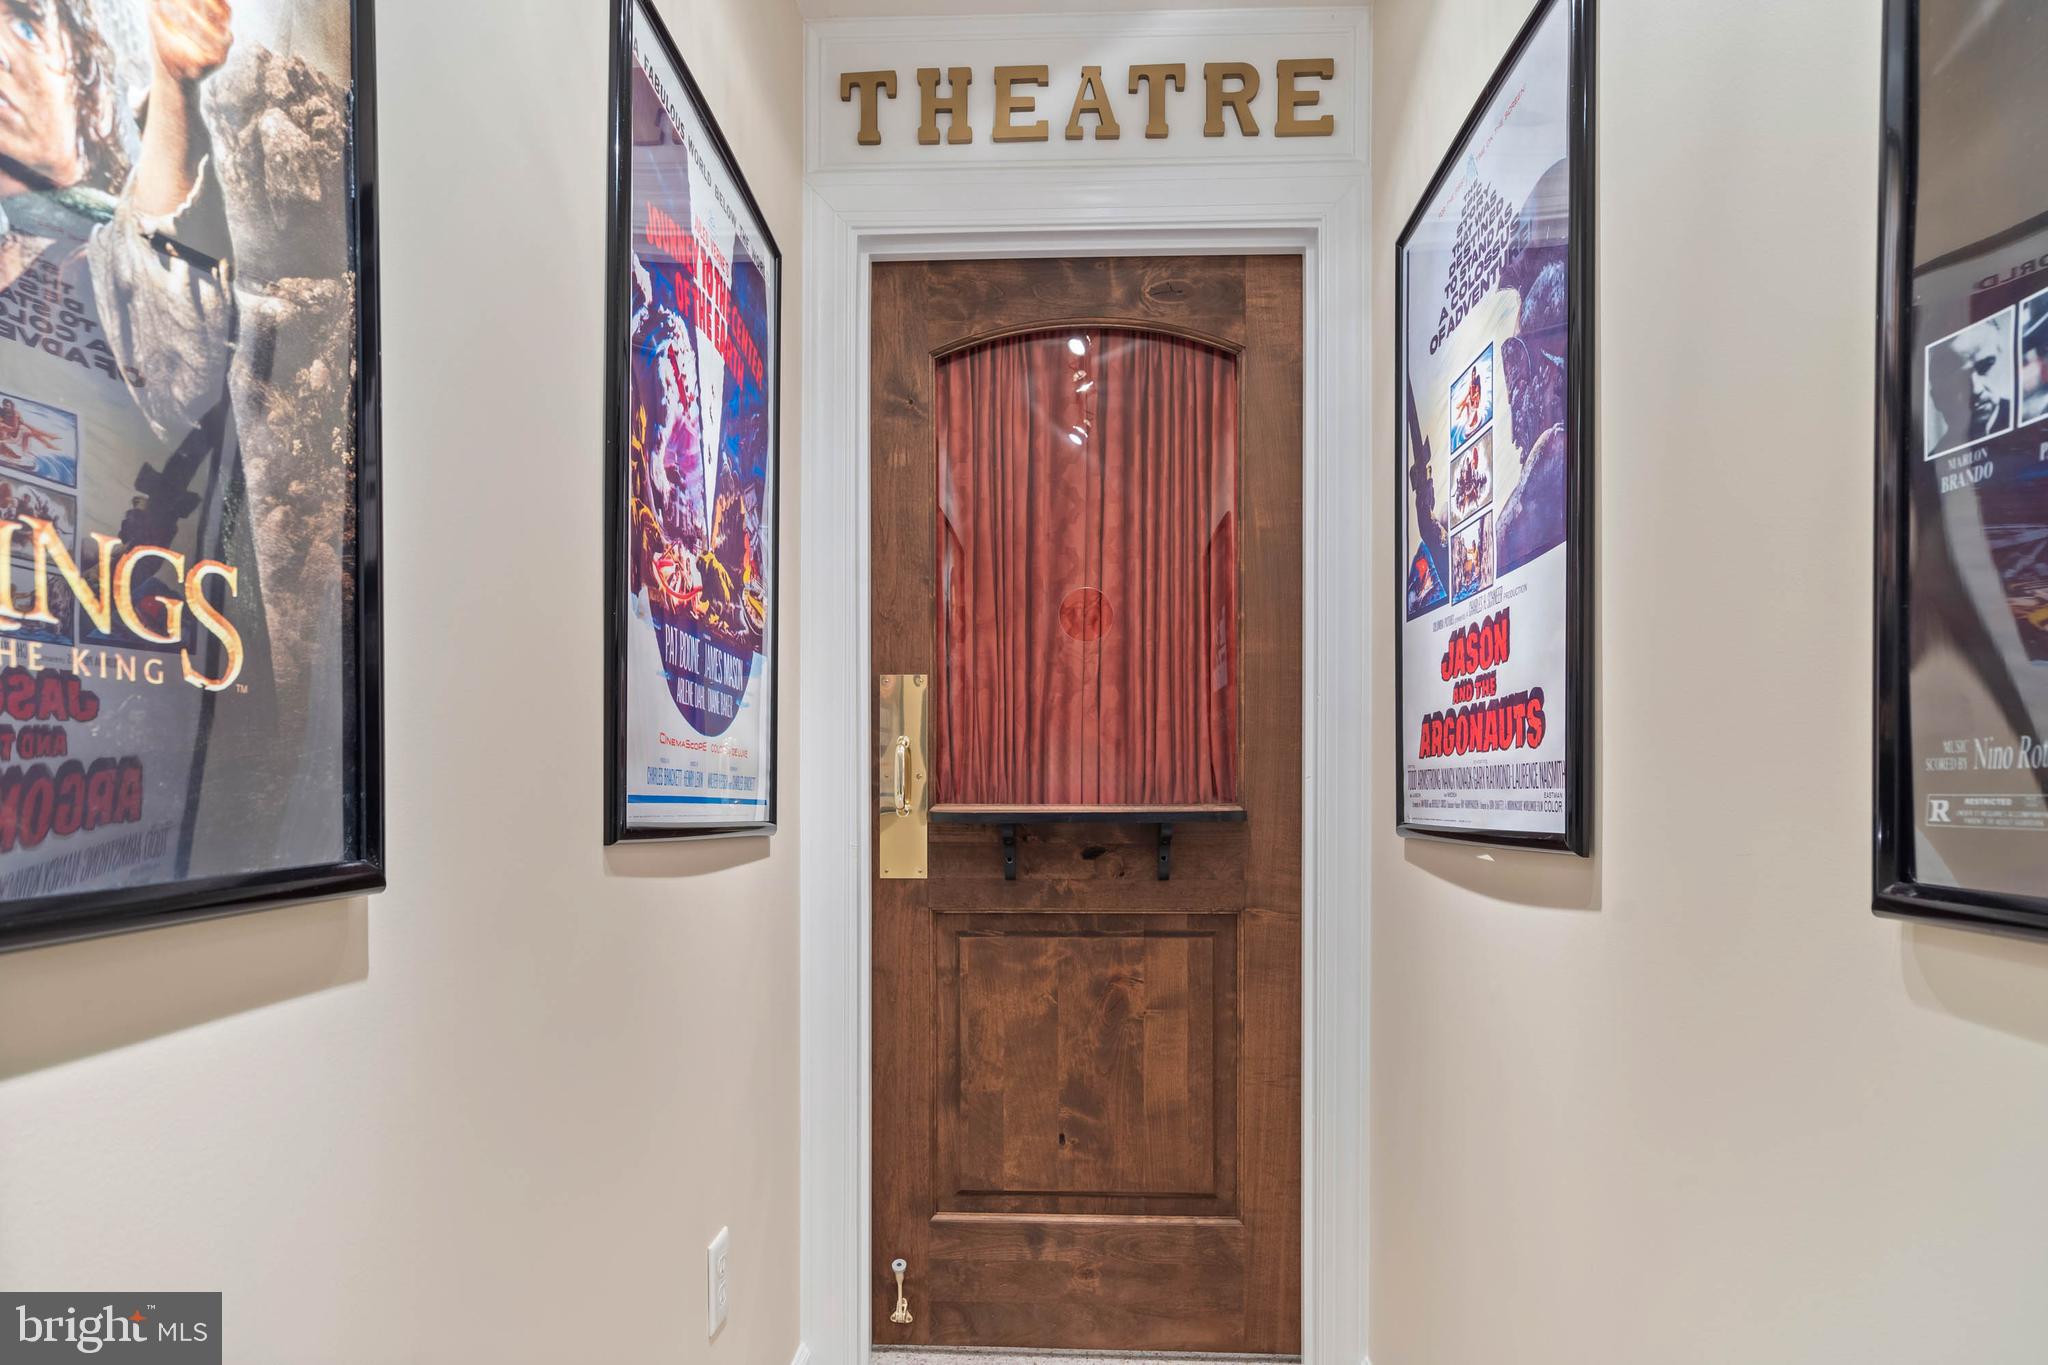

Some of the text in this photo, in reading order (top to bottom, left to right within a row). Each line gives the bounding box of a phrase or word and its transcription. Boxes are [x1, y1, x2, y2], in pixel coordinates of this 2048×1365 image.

[840, 57, 1335, 146] THEATRE
[644, 54, 685, 140] FABULOUS
[688, 136, 712, 188] WORLD
[714, 185, 737, 229] BELOW
[1452, 189, 1497, 258] THAT WAS
[1456, 181, 1491, 239] STORY
[1461, 182, 1483, 217] EPIC
[1438, 306, 1449, 327] A
[1450, 211, 1520, 310] COLOSSUS
[1444, 201, 1513, 300] TO STAND AS
[1449, 197, 1504, 280] DESTINED
[646, 201, 698, 280] JOURNEY
[701, 250, 713, 298] TO
[732, 304, 763, 391] CENTER
[675, 271, 744, 391] OF THE EARTH
[1429, 325, 1446, 356] OF
[1941, 461, 1994, 494] BRANDO
[1948, 447, 1988, 470] MARLON
[0, 514, 244, 692] INGS
[71, 646, 165, 686] KING
[665, 623, 744, 692] PAT BOONE JAMES MASON
[1440, 606, 1510, 682] JASON
[1453, 670, 1497, 705] AND THE
[1419, 687, 1546, 759] ARGONAUTS
[1972, 736, 2014, 770] Nino
[1543, 800, 1563, 813] COLOR
[1929, 799, 1951, 823] R
